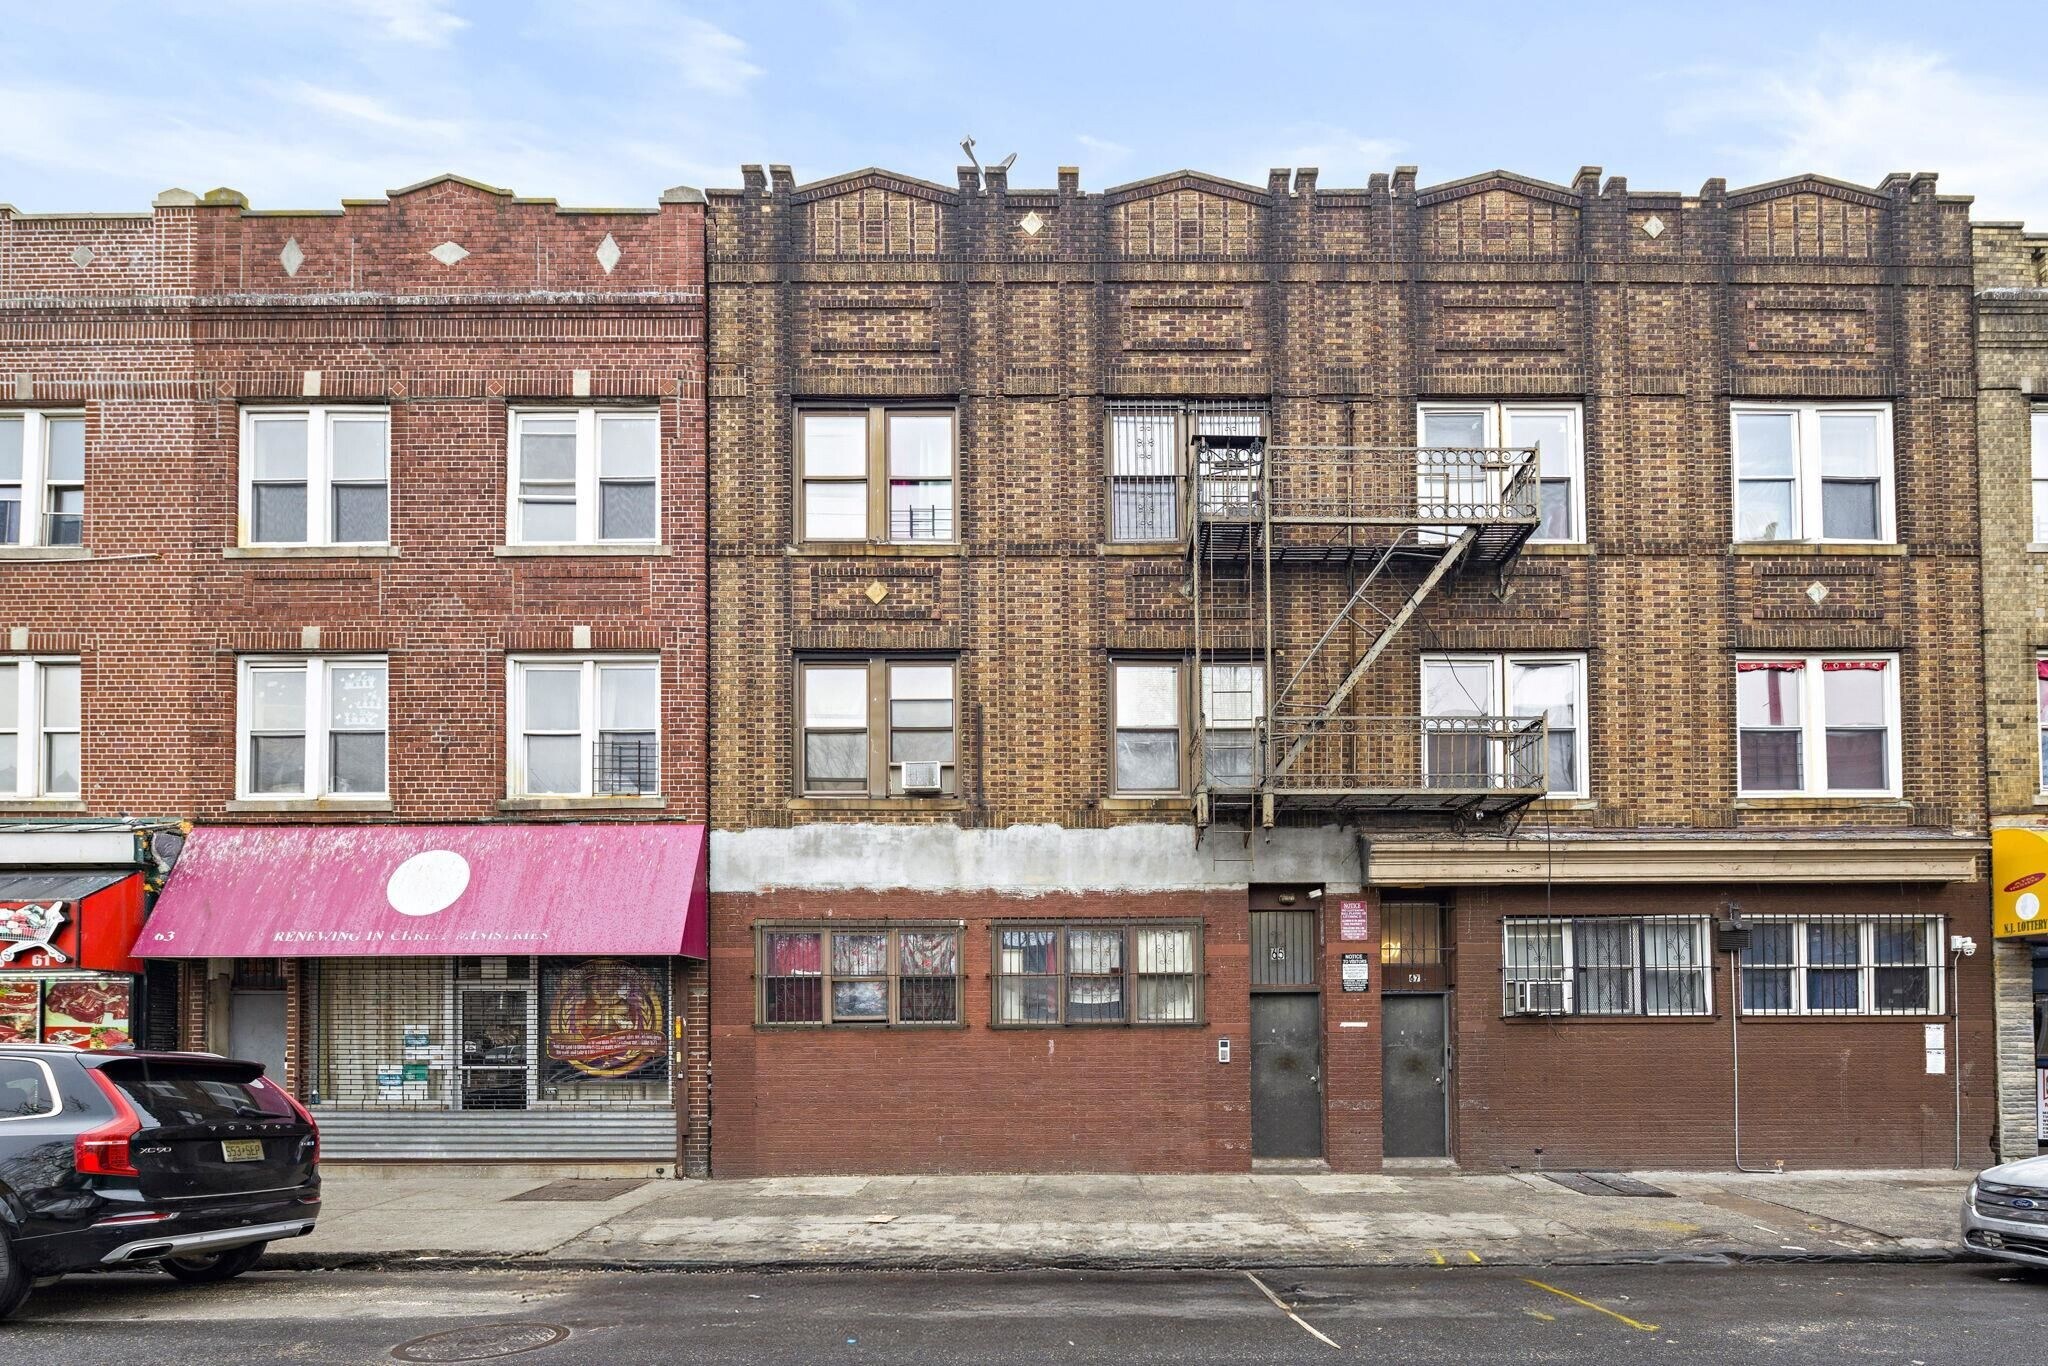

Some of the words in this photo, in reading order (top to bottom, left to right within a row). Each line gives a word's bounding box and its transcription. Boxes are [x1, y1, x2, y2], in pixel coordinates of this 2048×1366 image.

[2004, 923, 2016, 935] N.J.
[2017, 919, 2048, 932] LOTTERY
[273, 931, 360, 941] RENEWING
[366, 931, 384, 940] IN
[1270, 947, 1285, 960] 65
[31, 954, 51, 967] 61
